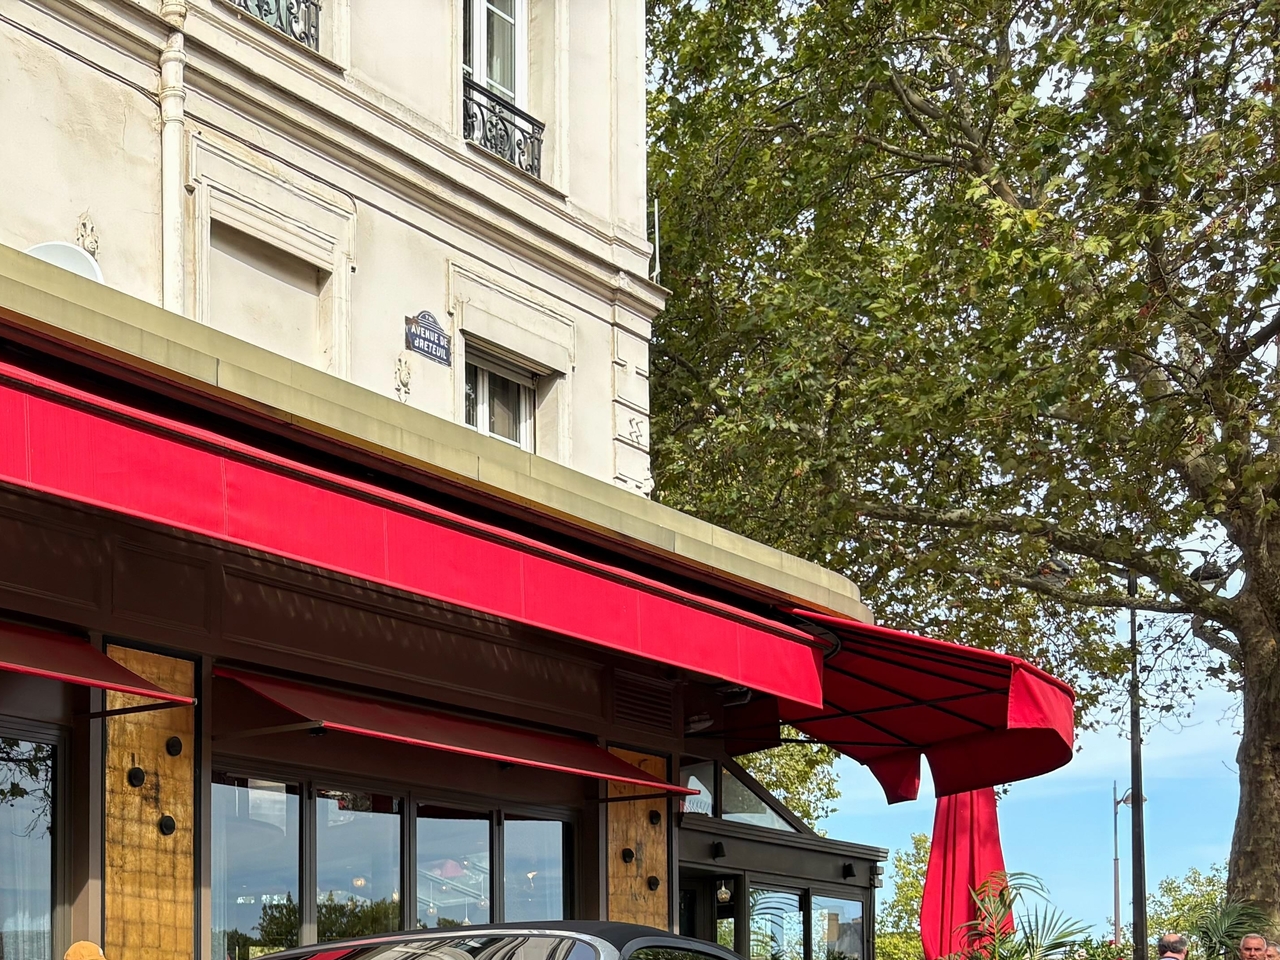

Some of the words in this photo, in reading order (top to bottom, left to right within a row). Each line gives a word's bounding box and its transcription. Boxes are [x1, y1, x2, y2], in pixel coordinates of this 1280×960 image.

[411, 324, 439, 343] AVENUE
[440, 333, 449, 348] DE
[414, 337, 447, 360] BRETEUIL
